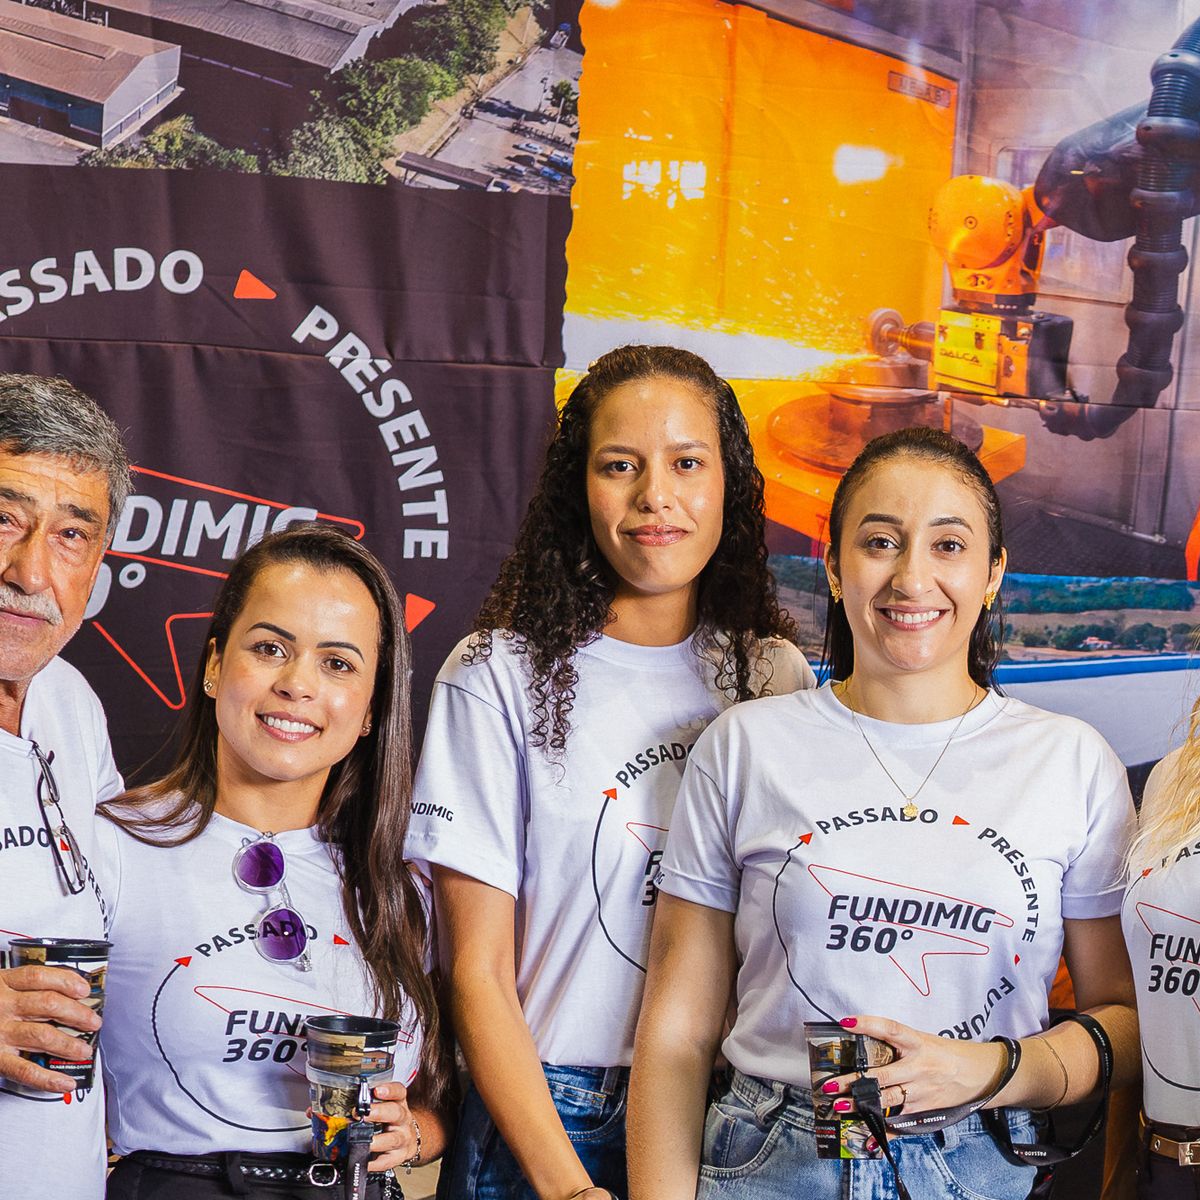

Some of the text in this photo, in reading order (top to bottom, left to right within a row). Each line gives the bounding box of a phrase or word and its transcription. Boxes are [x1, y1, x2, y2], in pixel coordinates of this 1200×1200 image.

[0, 246, 450, 560] SSADO PRESENTE
[111, 494, 320, 560] DIMI
[410, 802, 454, 822] NDIMIG
[977, 827, 1040, 944] PRESENTE
[825, 924, 914, 955] 360°
[827, 894, 997, 934] FUNDIMIG
